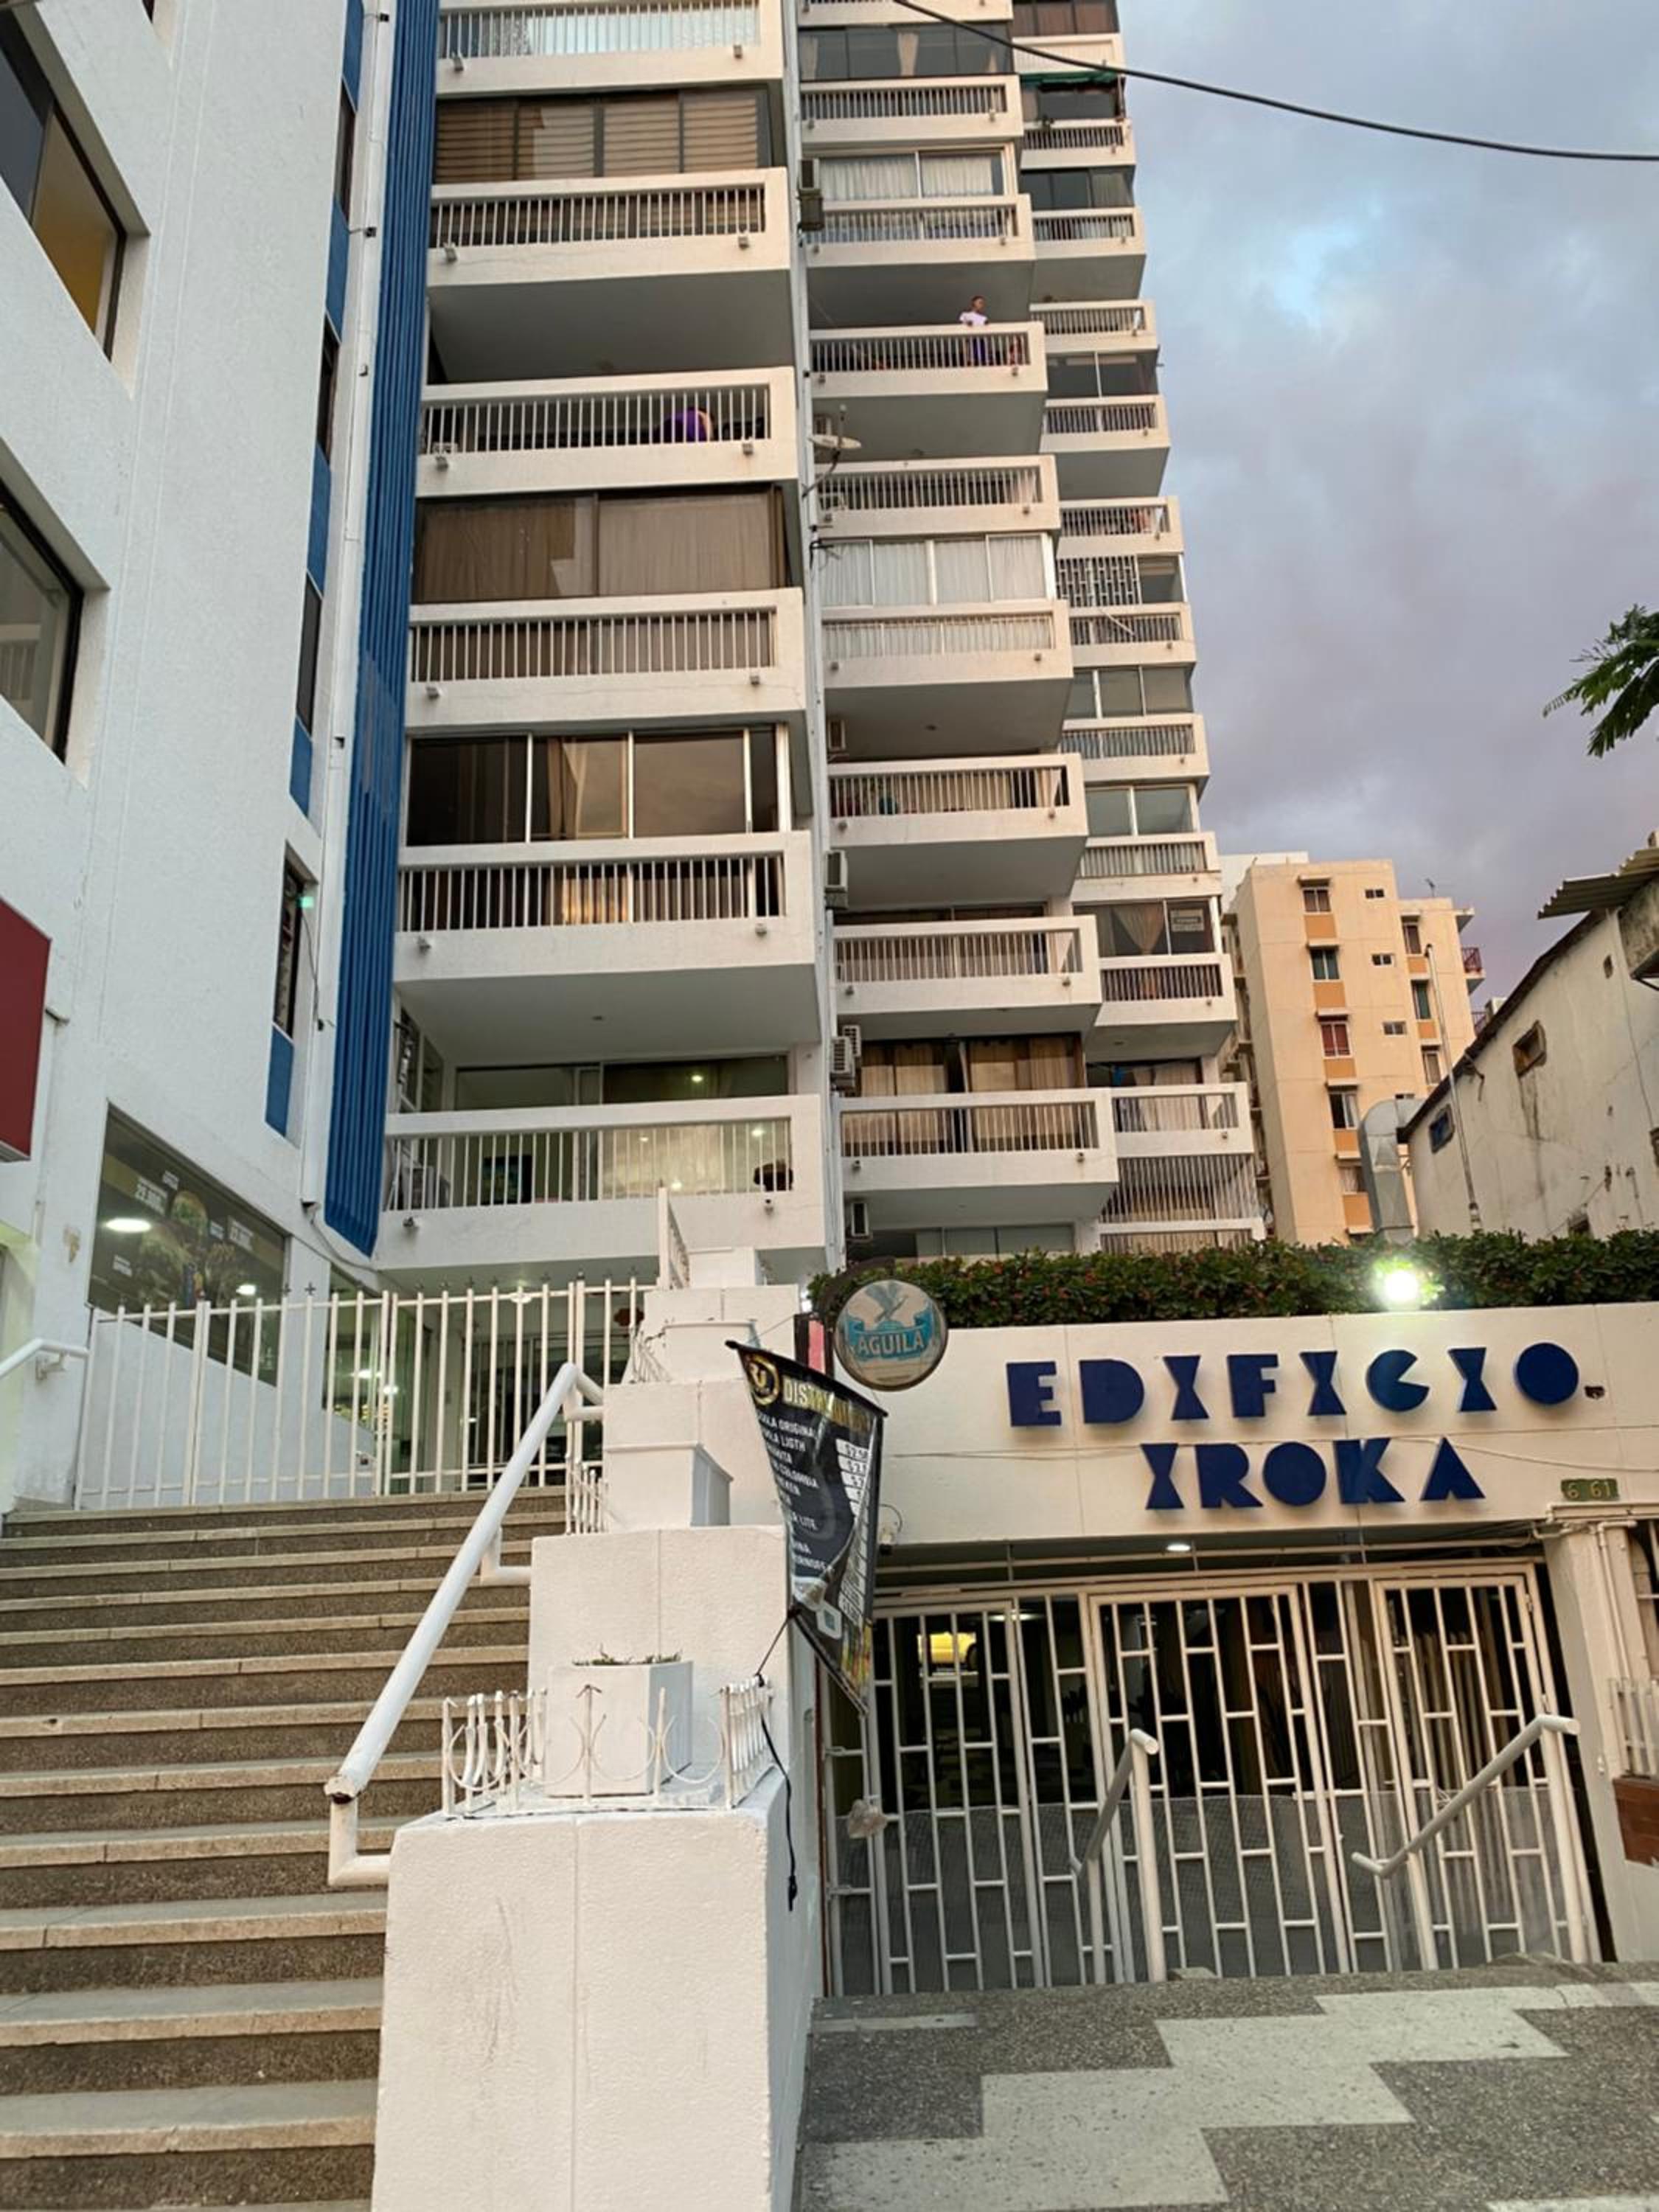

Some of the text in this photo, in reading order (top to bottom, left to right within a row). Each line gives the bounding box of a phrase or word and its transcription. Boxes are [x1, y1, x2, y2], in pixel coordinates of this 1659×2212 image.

[858, 1330, 925, 1355] AGUILA
[1006, 1342, 1579, 1427] EDIFICIO
[1140, 1437, 1486, 1510] IROKA
